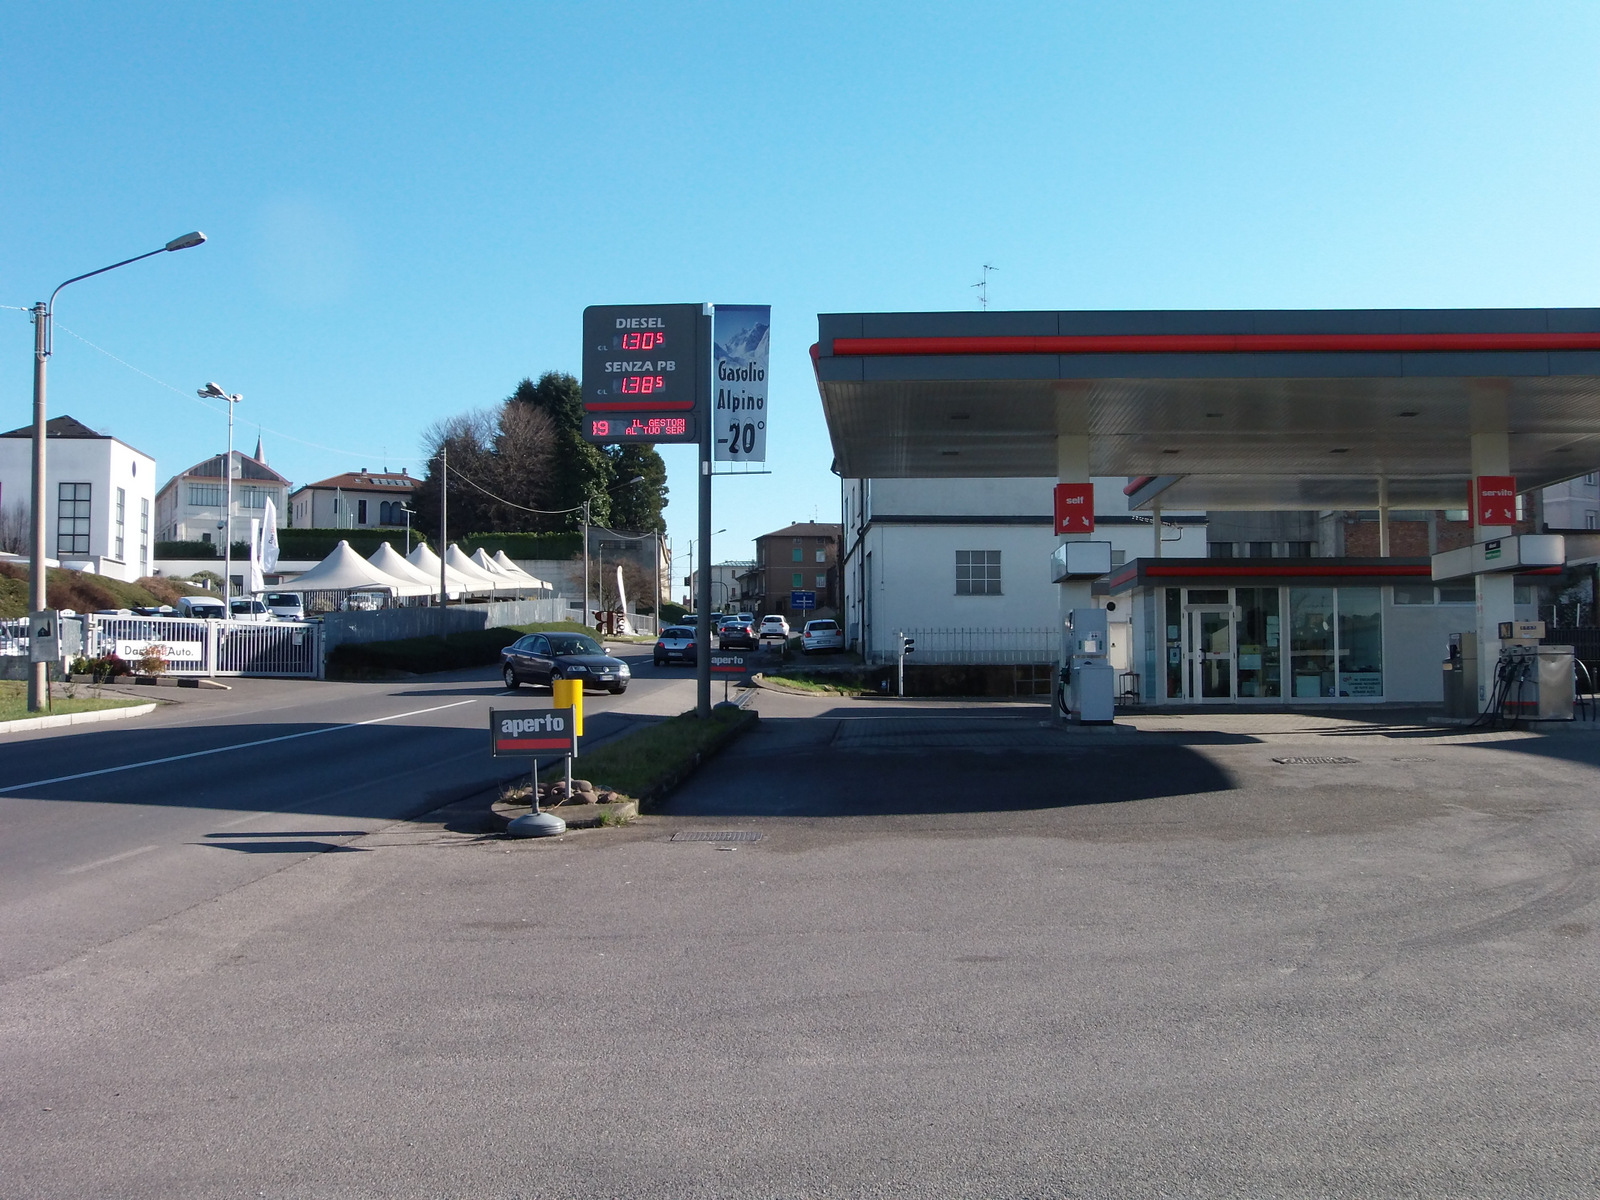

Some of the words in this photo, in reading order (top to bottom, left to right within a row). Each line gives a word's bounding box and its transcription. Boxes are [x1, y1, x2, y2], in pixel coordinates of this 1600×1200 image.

[616, 318, 665, 329] DIESEL
[605, 361, 654, 372] SENZA
[657, 360, 676, 371] PB
[717, 360, 765, 382] Gasolio
[717, 388, 764, 413] Alpino
[632, 418, 644, 427] IL
[625, 427, 637, 435] AL
[643, 426, 661, 435] TUO
[1482, 489, 1513, 497] servito
[1066, 496, 1085, 505] self
[711, 655, 744, 665] aperto
[501, 713, 565, 737] aperto
